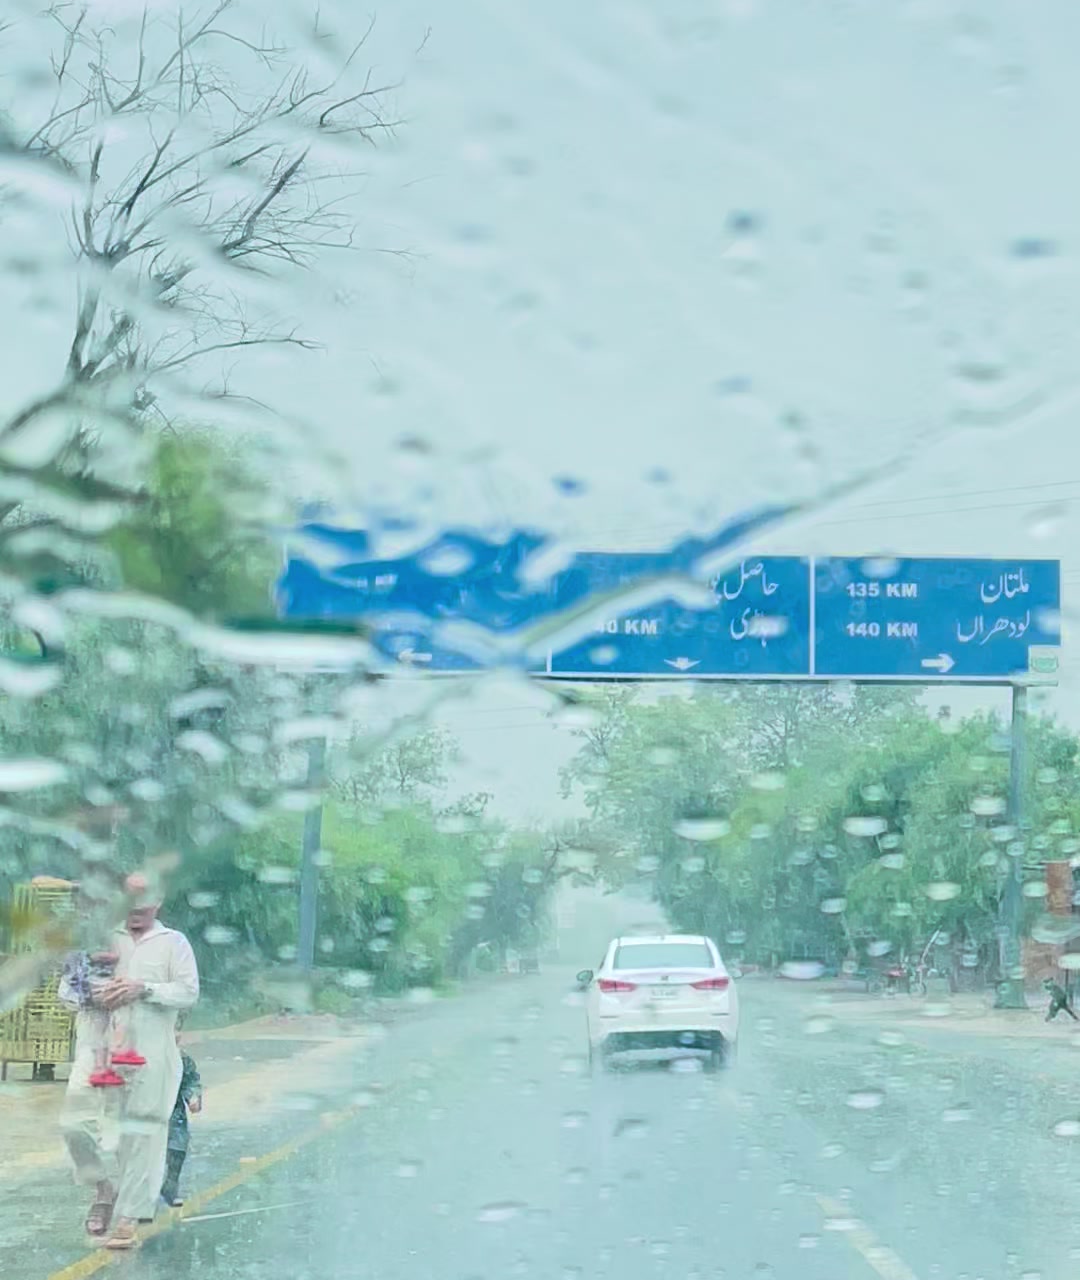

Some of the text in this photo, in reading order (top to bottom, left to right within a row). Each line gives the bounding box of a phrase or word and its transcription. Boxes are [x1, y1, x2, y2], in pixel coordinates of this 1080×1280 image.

[846, 582, 918, 598] 135 KM
[980, 568, 1030, 603] ملتان
[625, 619, 658, 635] KM
[846, 622, 918, 637] 140 KM
[957, 610, 1030, 646] لودھراں
